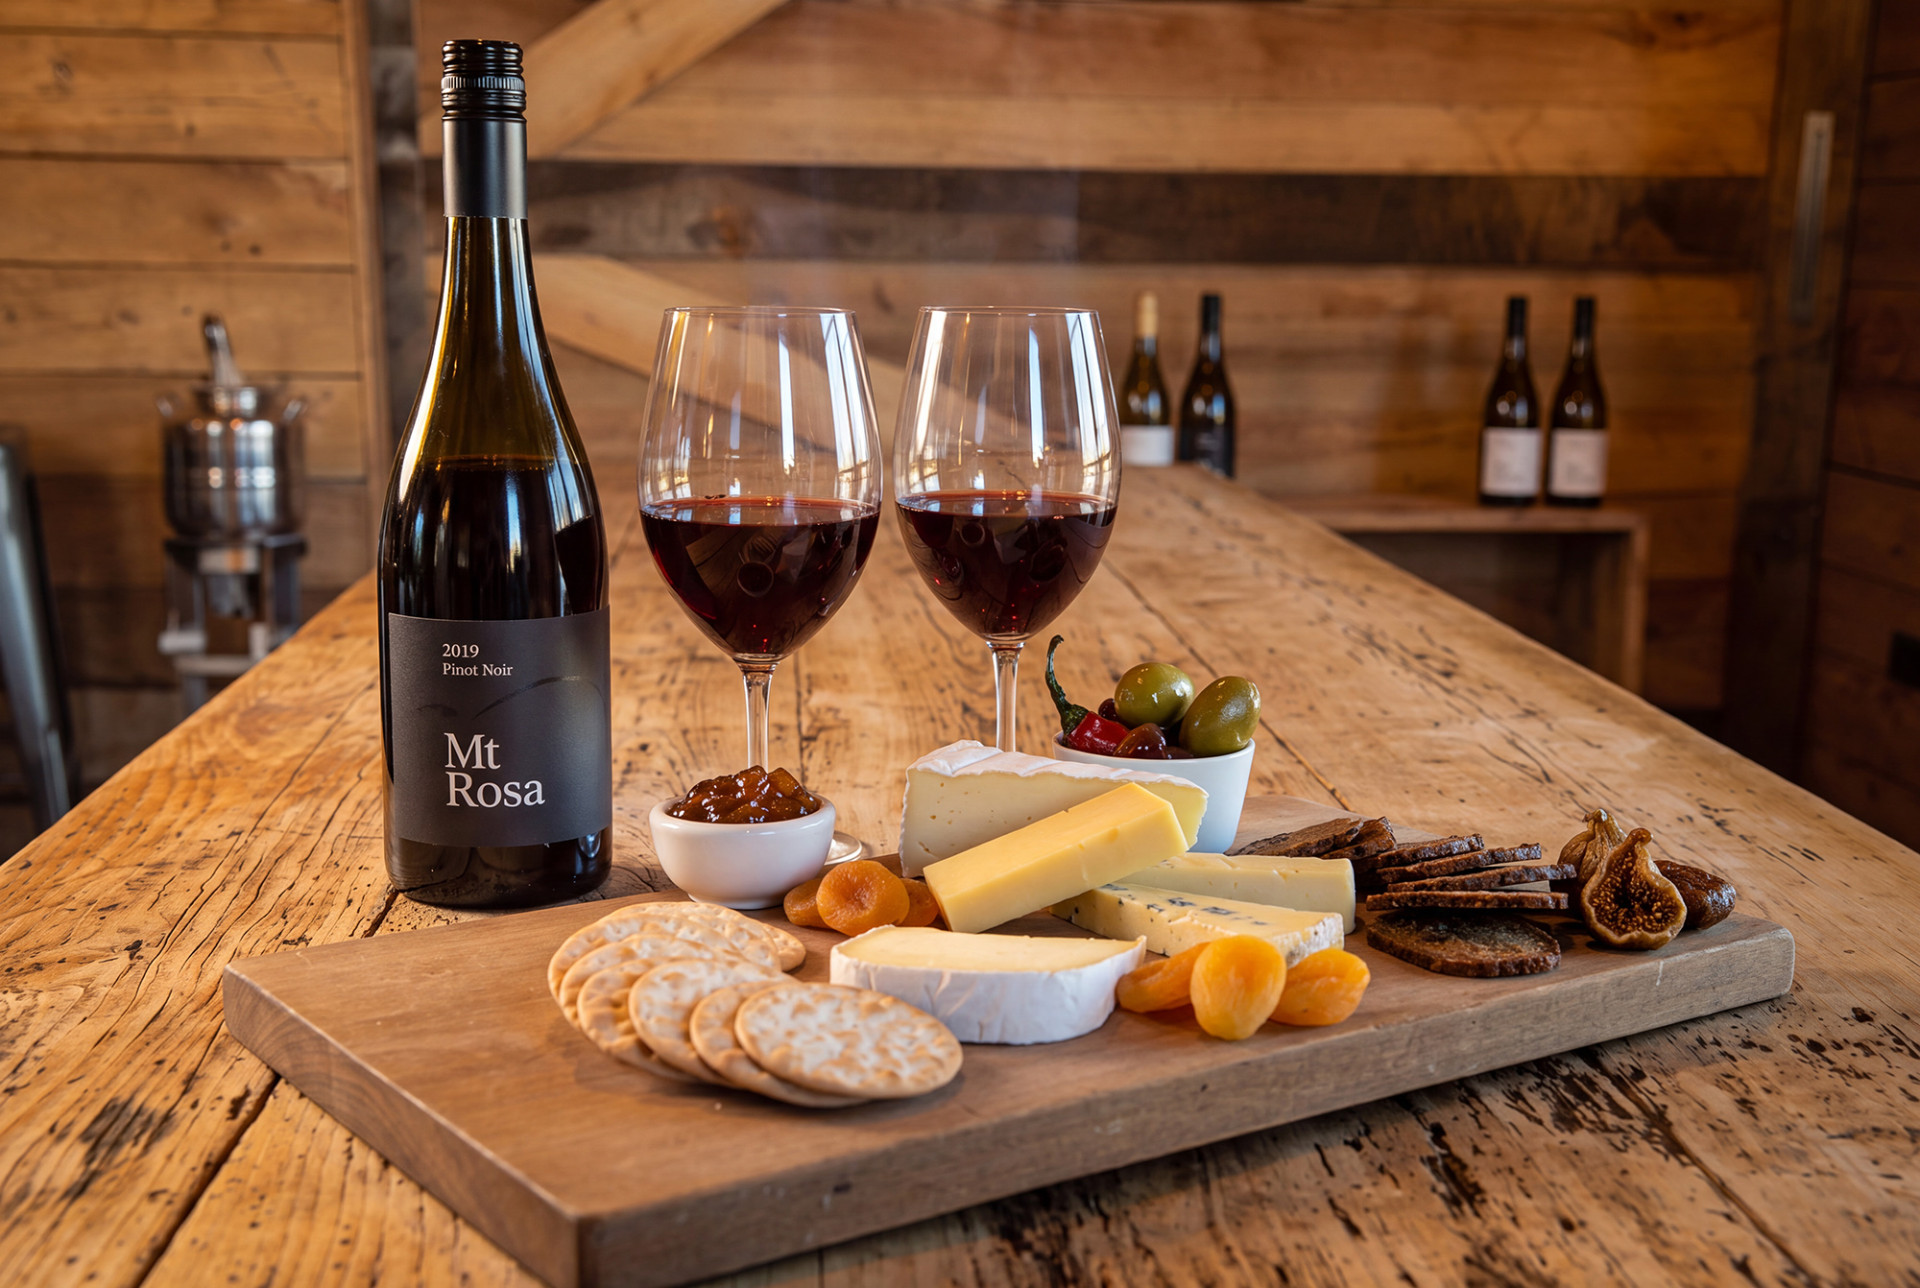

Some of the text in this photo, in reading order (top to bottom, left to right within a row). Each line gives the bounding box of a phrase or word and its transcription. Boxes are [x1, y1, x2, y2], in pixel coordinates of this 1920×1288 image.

[442, 643, 480, 658] 2019
[442, 662, 514, 676] Pinot Noir
[443, 732, 501, 770] Mt
[445, 771, 546, 808] Rosa
